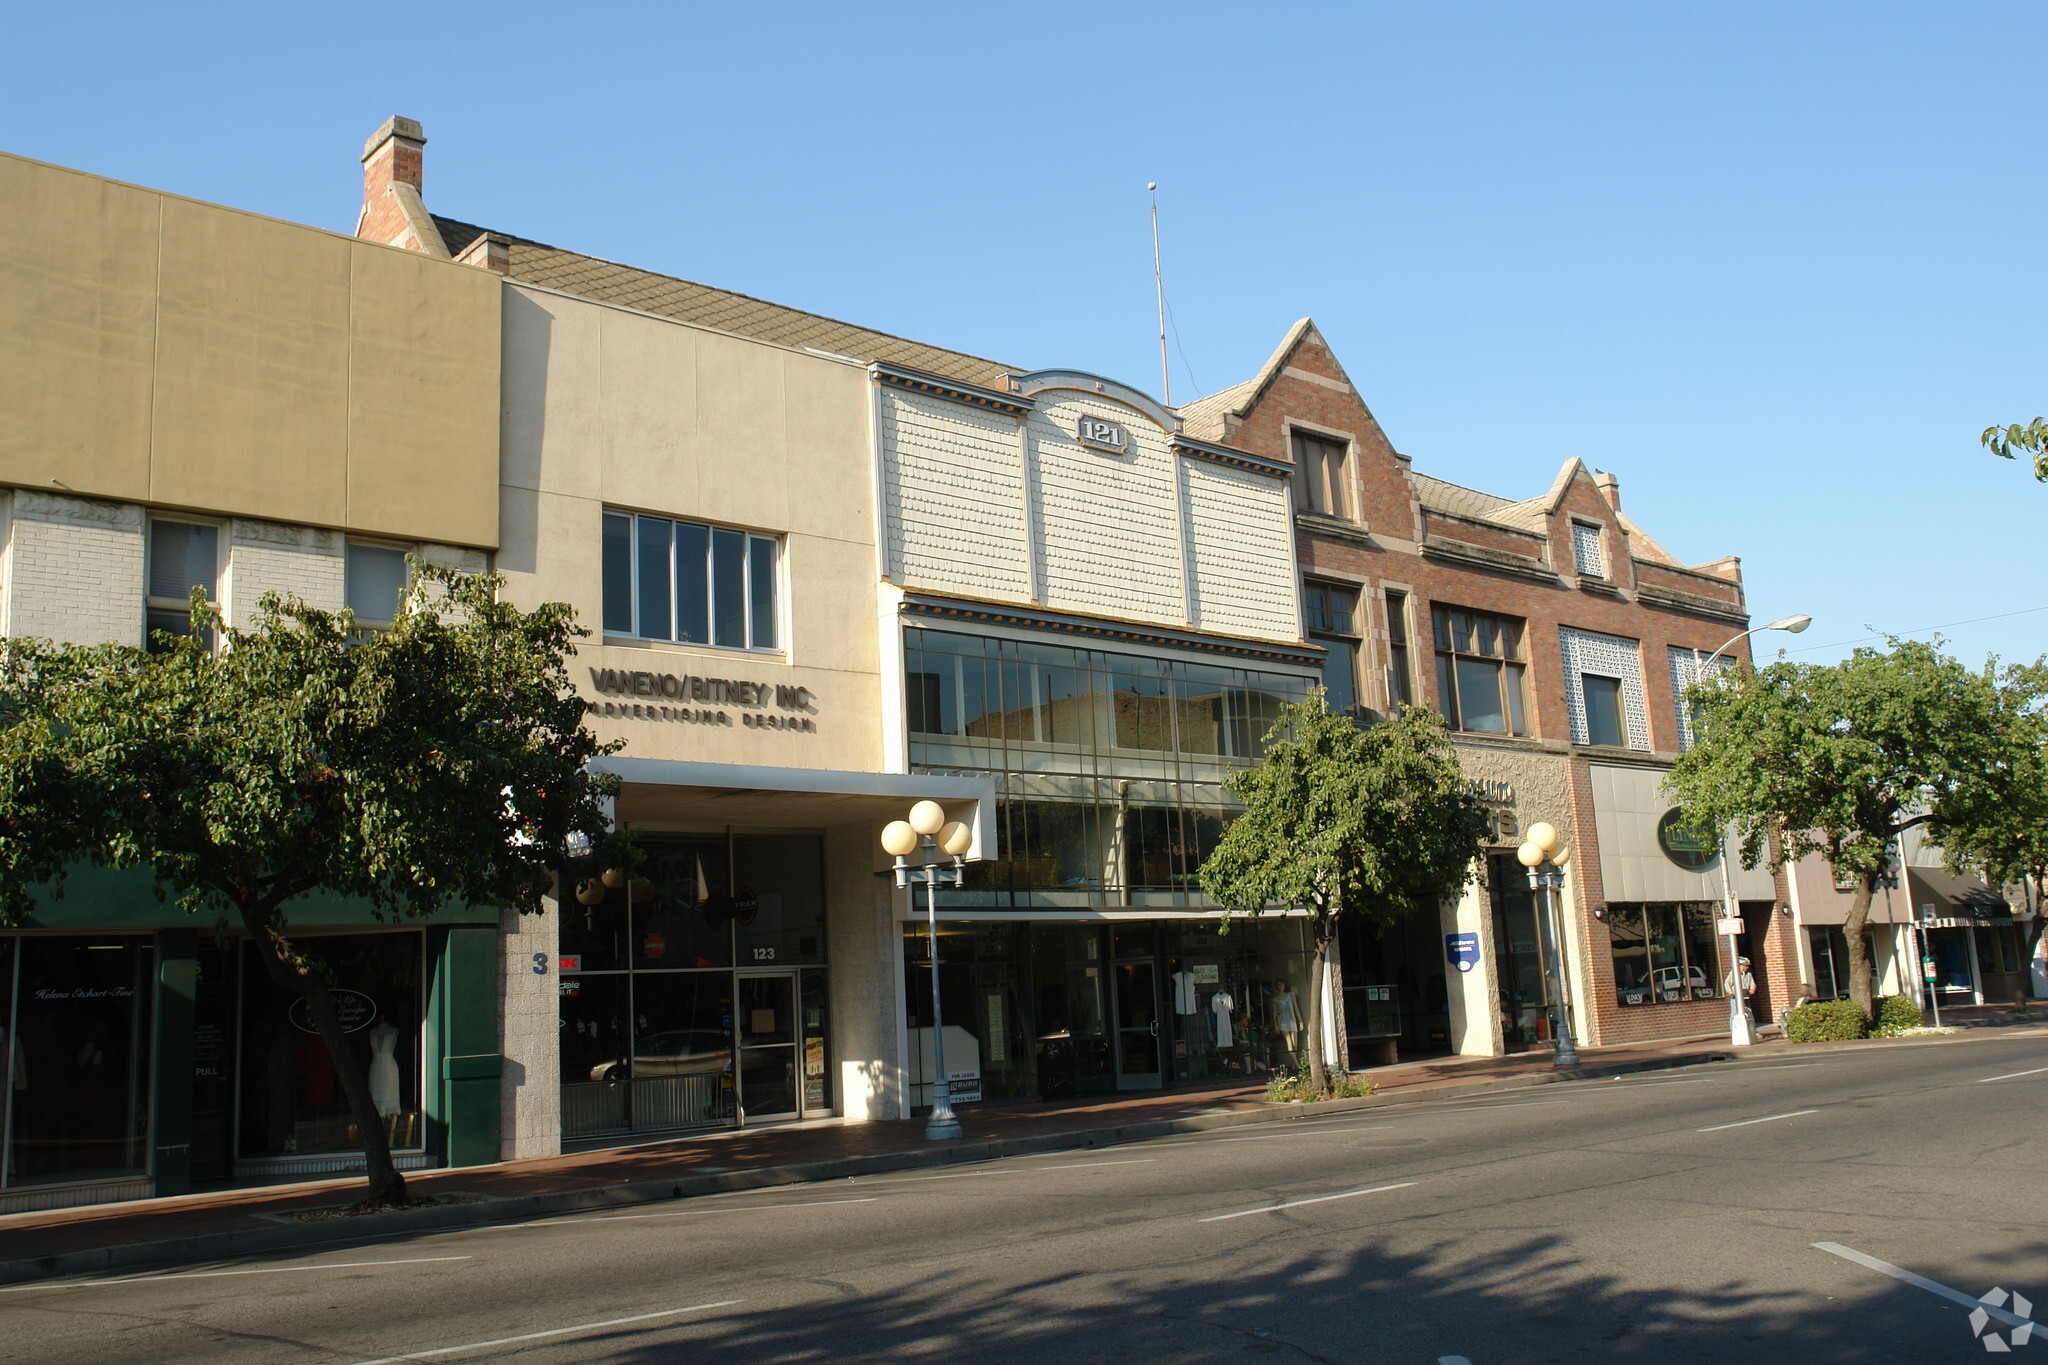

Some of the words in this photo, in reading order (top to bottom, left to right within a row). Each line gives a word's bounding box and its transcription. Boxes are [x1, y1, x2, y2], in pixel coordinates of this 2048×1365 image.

[1083, 421, 1121, 446] 121
[588, 667, 767, 705] VANENO/BITNEY
[776, 684, 811, 709] INC
[592, 701, 727, 724] ADVERTISING
[742, 713, 811, 730] DESIGN
[533, 953, 548, 975] 3
[752, 947, 776, 961] 123
[34, 988, 69, 1000] Helena
[195, 1067, 219, 1076] PULL
